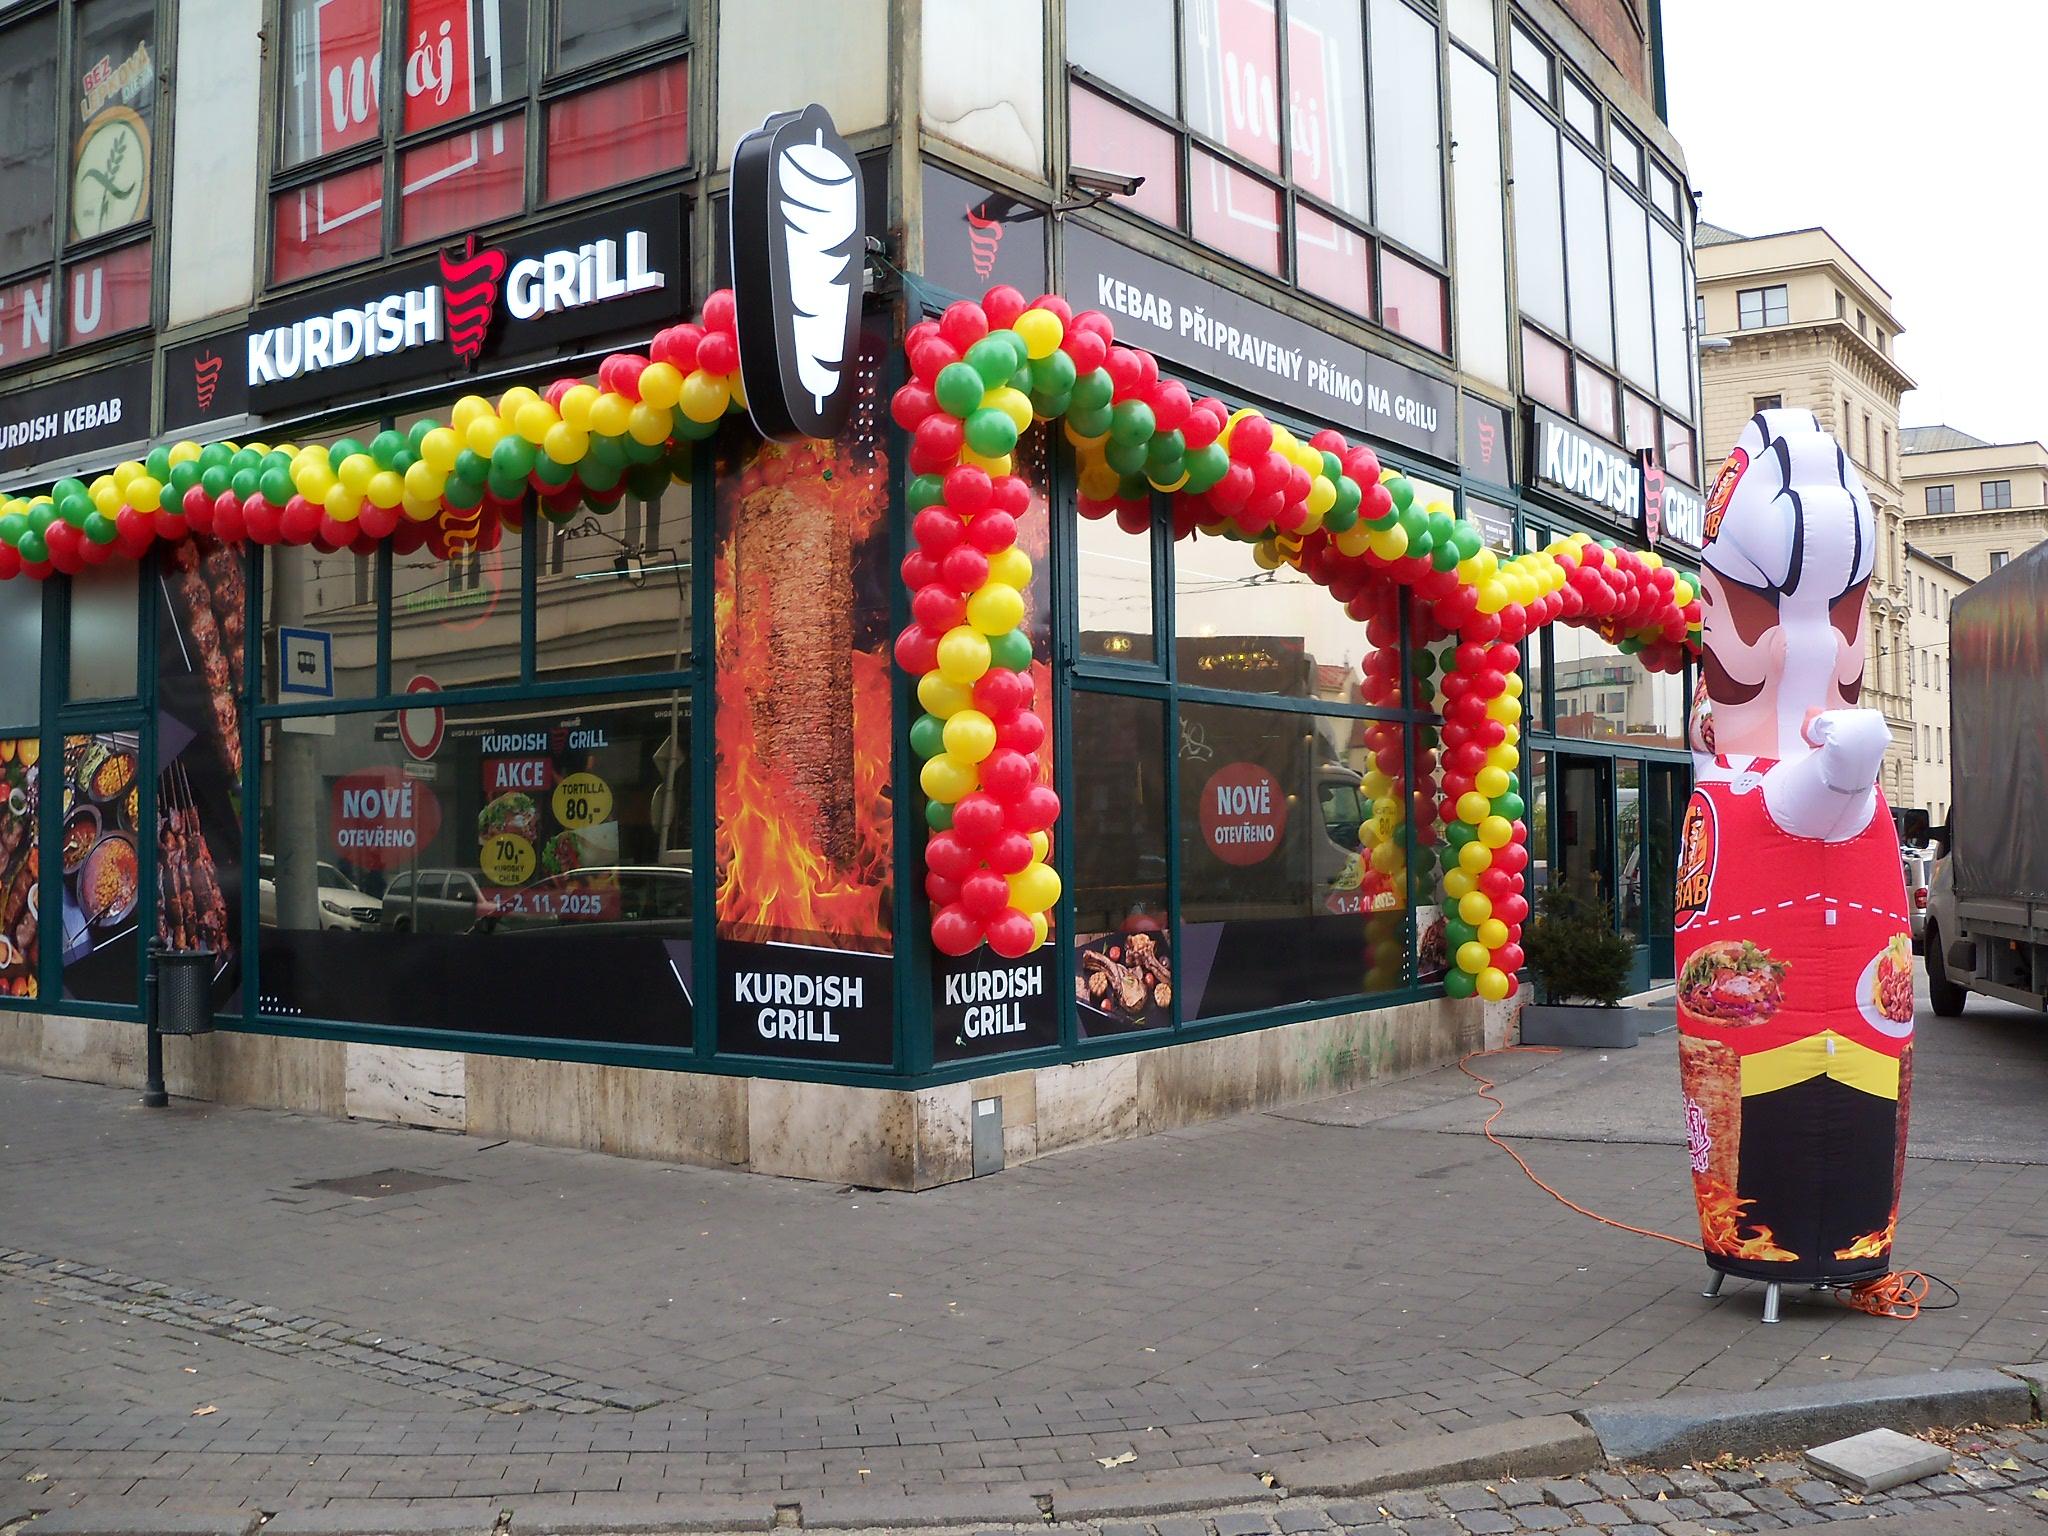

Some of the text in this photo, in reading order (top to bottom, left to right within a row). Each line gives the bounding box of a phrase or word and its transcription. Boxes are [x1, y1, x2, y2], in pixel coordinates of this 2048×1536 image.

[84, 56, 111, 94] BEZ
[0, 268, 102, 355] NU
[1098, 274, 1438, 433] KEBAB PŘIPRAVENÝ PŘÍMO NA GRILU
[63, 398, 122, 434] KEBAB
[495, 761, 544, 787] AKCE
[342, 782, 413, 819] NOVĚ
[562, 783, 605, 796] TORTILLA
[1216, 780, 1271, 815] NOVĚ
[565, 798, 601, 824] 80,-
[338, 826, 417, 848] OTEVŘENO
[1214, 822, 1275, 845] OTEVŘENO
[496, 840, 524, 864] 70,-
[533, 894, 556, 913] 11.
[560, 893, 602, 914] 2025
